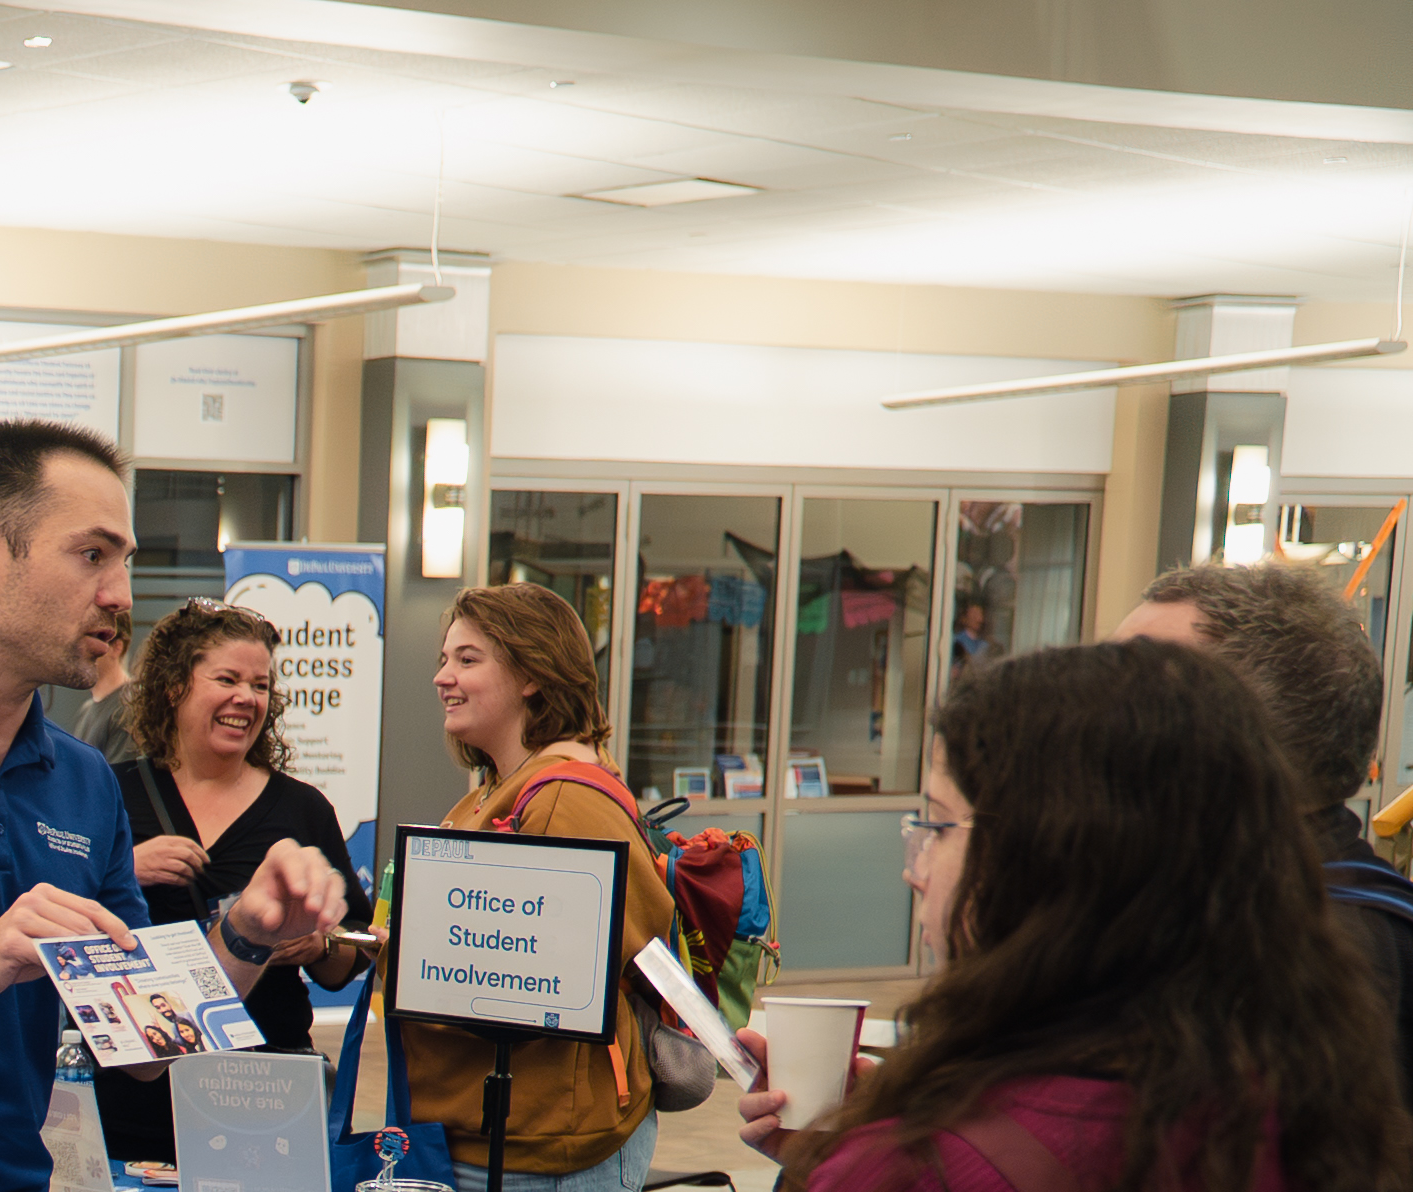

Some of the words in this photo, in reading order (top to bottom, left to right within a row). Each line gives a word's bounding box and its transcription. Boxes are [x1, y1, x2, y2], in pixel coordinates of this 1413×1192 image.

[279, 620, 356, 648] udent
[280, 657, 354, 678] ccess
[288, 687, 342, 715] nge
[411, 837, 474, 859] DEPAUL
[447, 888, 515, 914] Office
[522, 895, 545, 916] of
[83, 943, 112, 956] OFFICE
[448, 925, 538, 954] Student
[94, 958, 151, 973] INVOLVEMENT
[420, 959, 561, 995] Involvement
